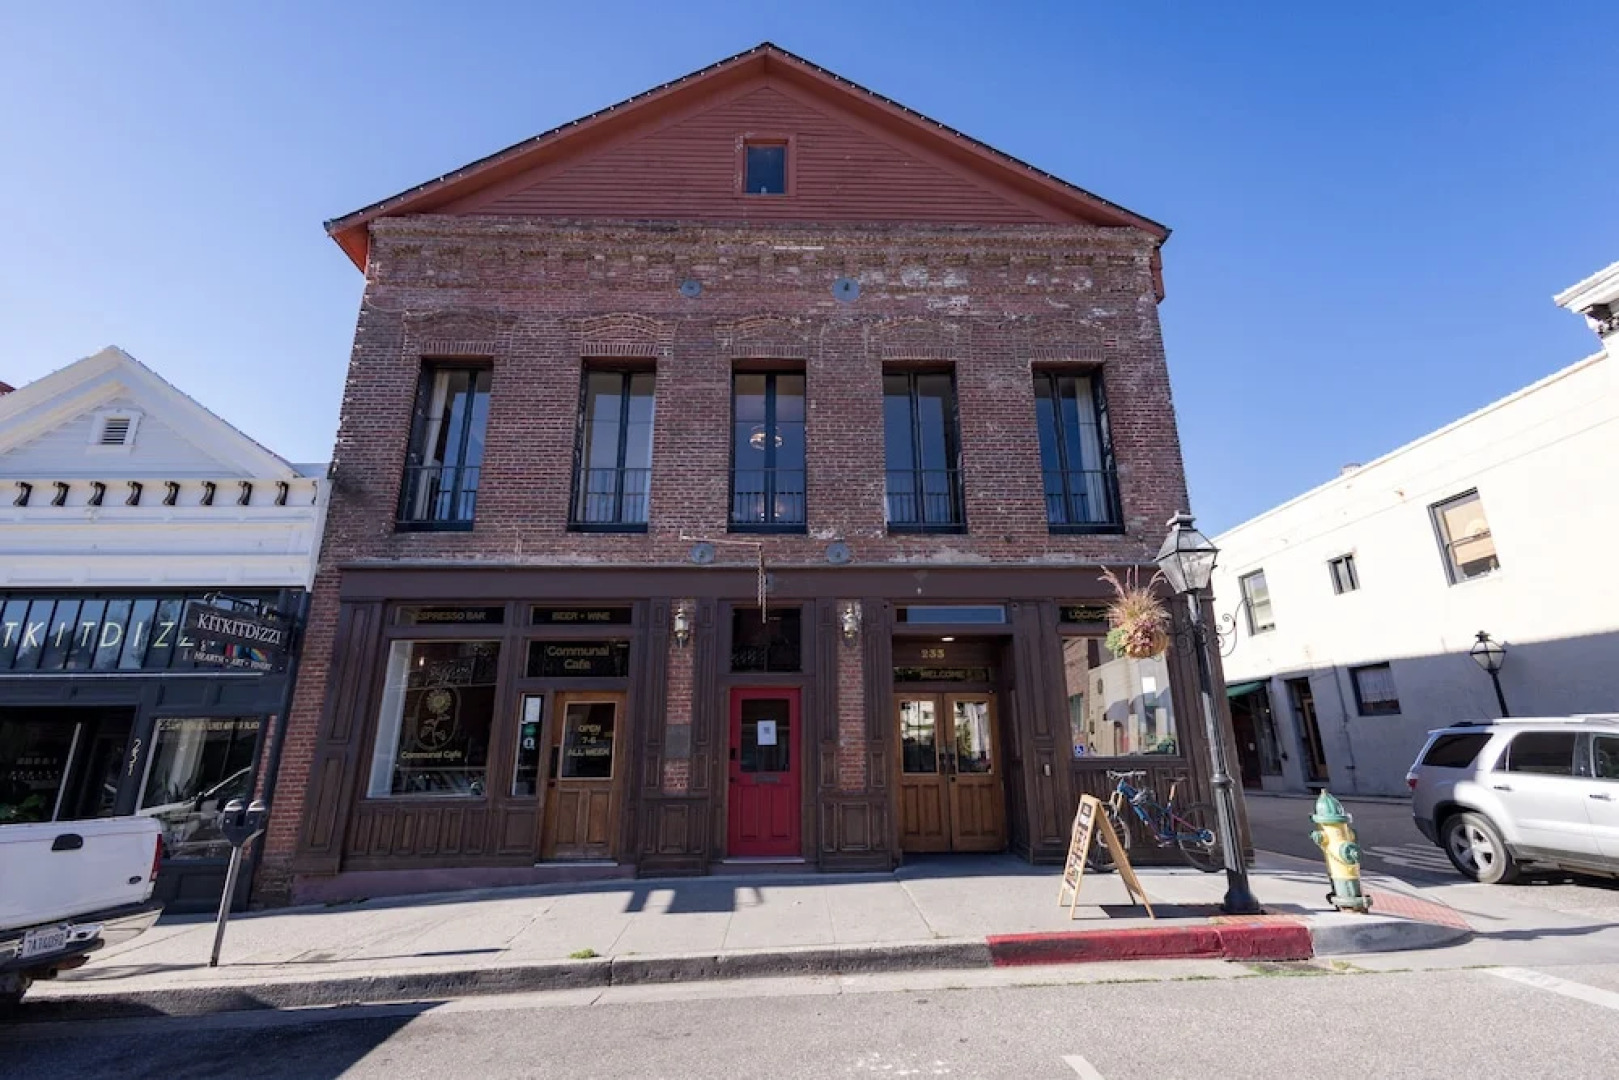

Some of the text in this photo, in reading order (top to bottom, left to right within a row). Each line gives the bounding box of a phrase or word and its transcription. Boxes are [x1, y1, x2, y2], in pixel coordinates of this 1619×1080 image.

[466, 611, 486, 621] BAR
[551, 611, 611, 621] BEER WINE
[197, 612, 282, 645] KITKITDIZZI
[547, 645, 610, 656] Communal
[194, 651, 225, 663] HEARTH
[230, 658, 245, 667] ART
[564, 658, 592, 670] Cafe
[920, 669, 966, 680] WELCOME
[577, 724, 602, 733] OPEN
[401, 750, 462, 761] Communal Cafe
[567, 747, 610, 756] ALL WEEK
